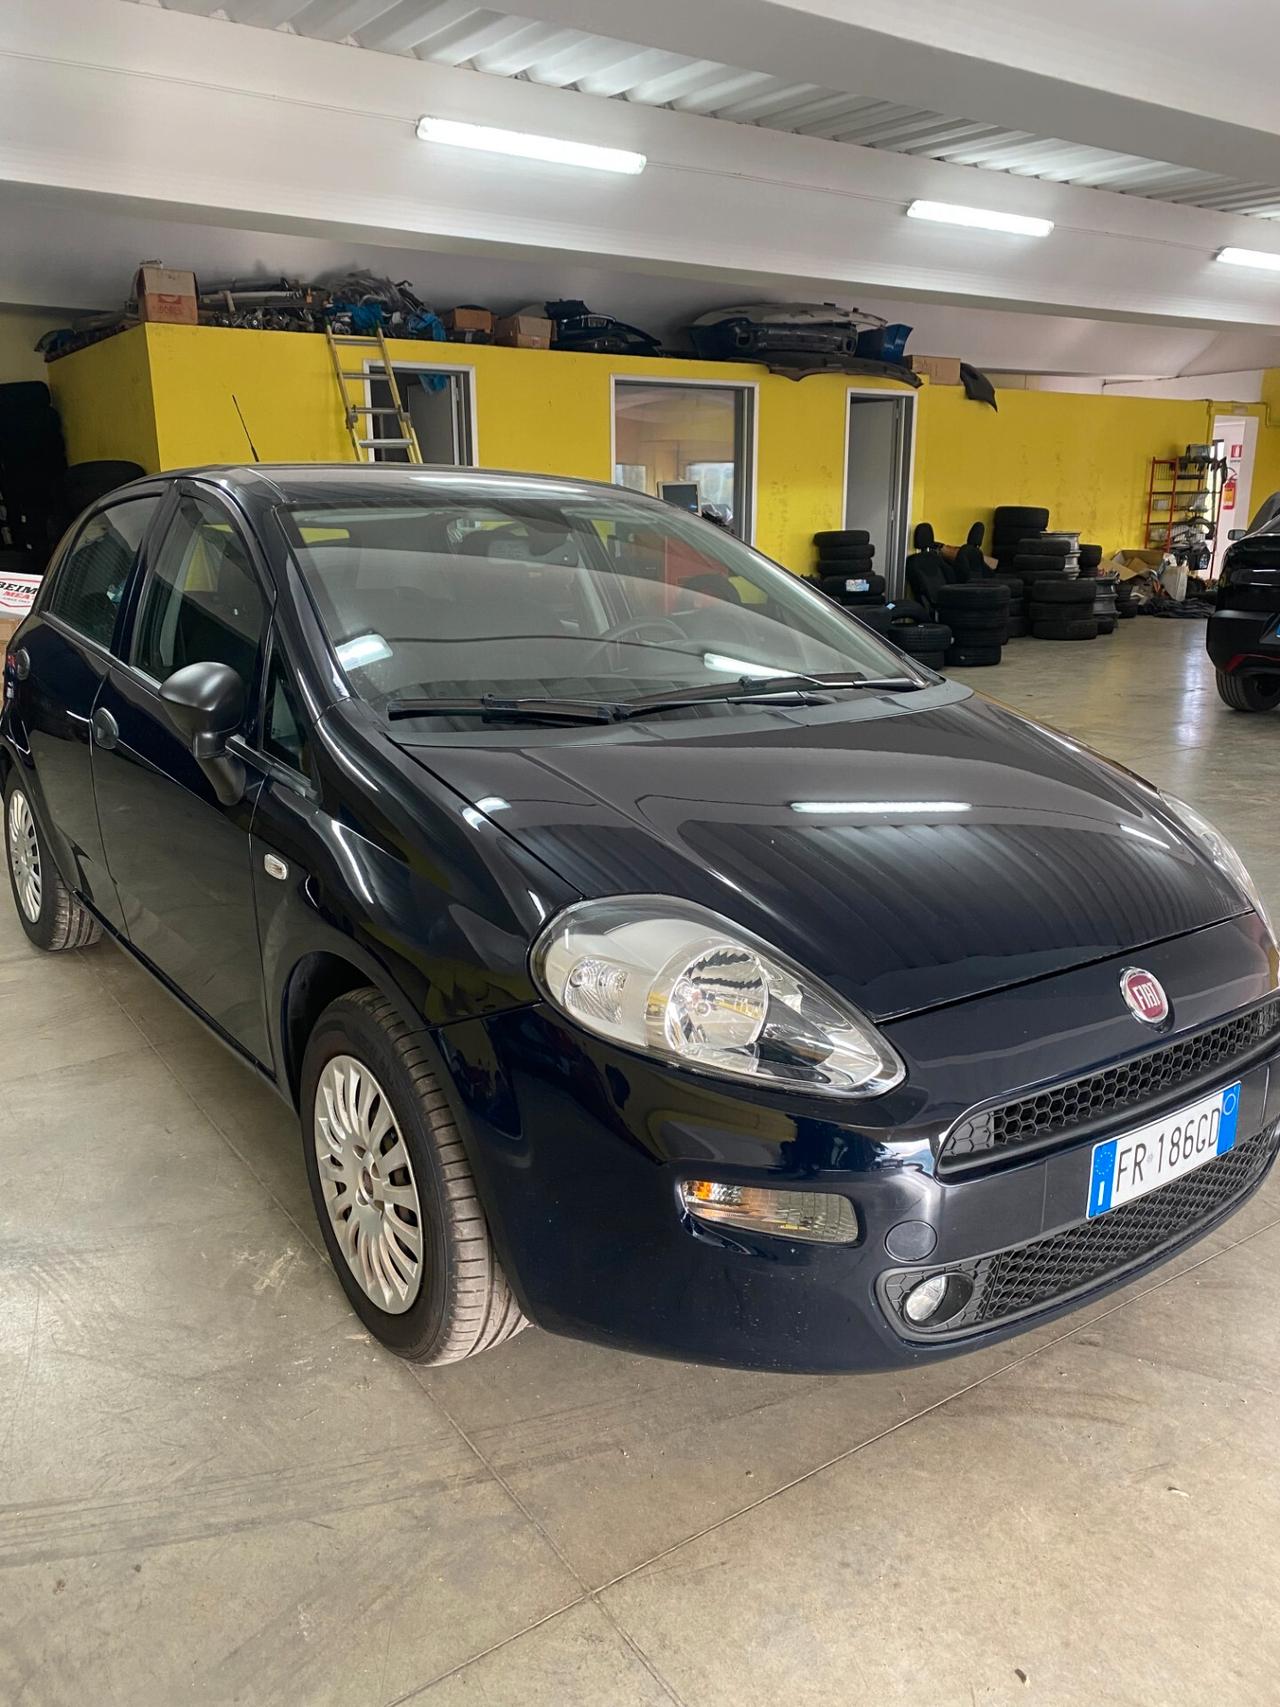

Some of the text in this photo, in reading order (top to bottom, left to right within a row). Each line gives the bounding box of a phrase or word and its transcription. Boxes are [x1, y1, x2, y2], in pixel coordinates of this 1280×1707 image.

[1132, 982, 1161, 1010] FIAT
[1116, 1107, 1221, 1193] FR 186GD
